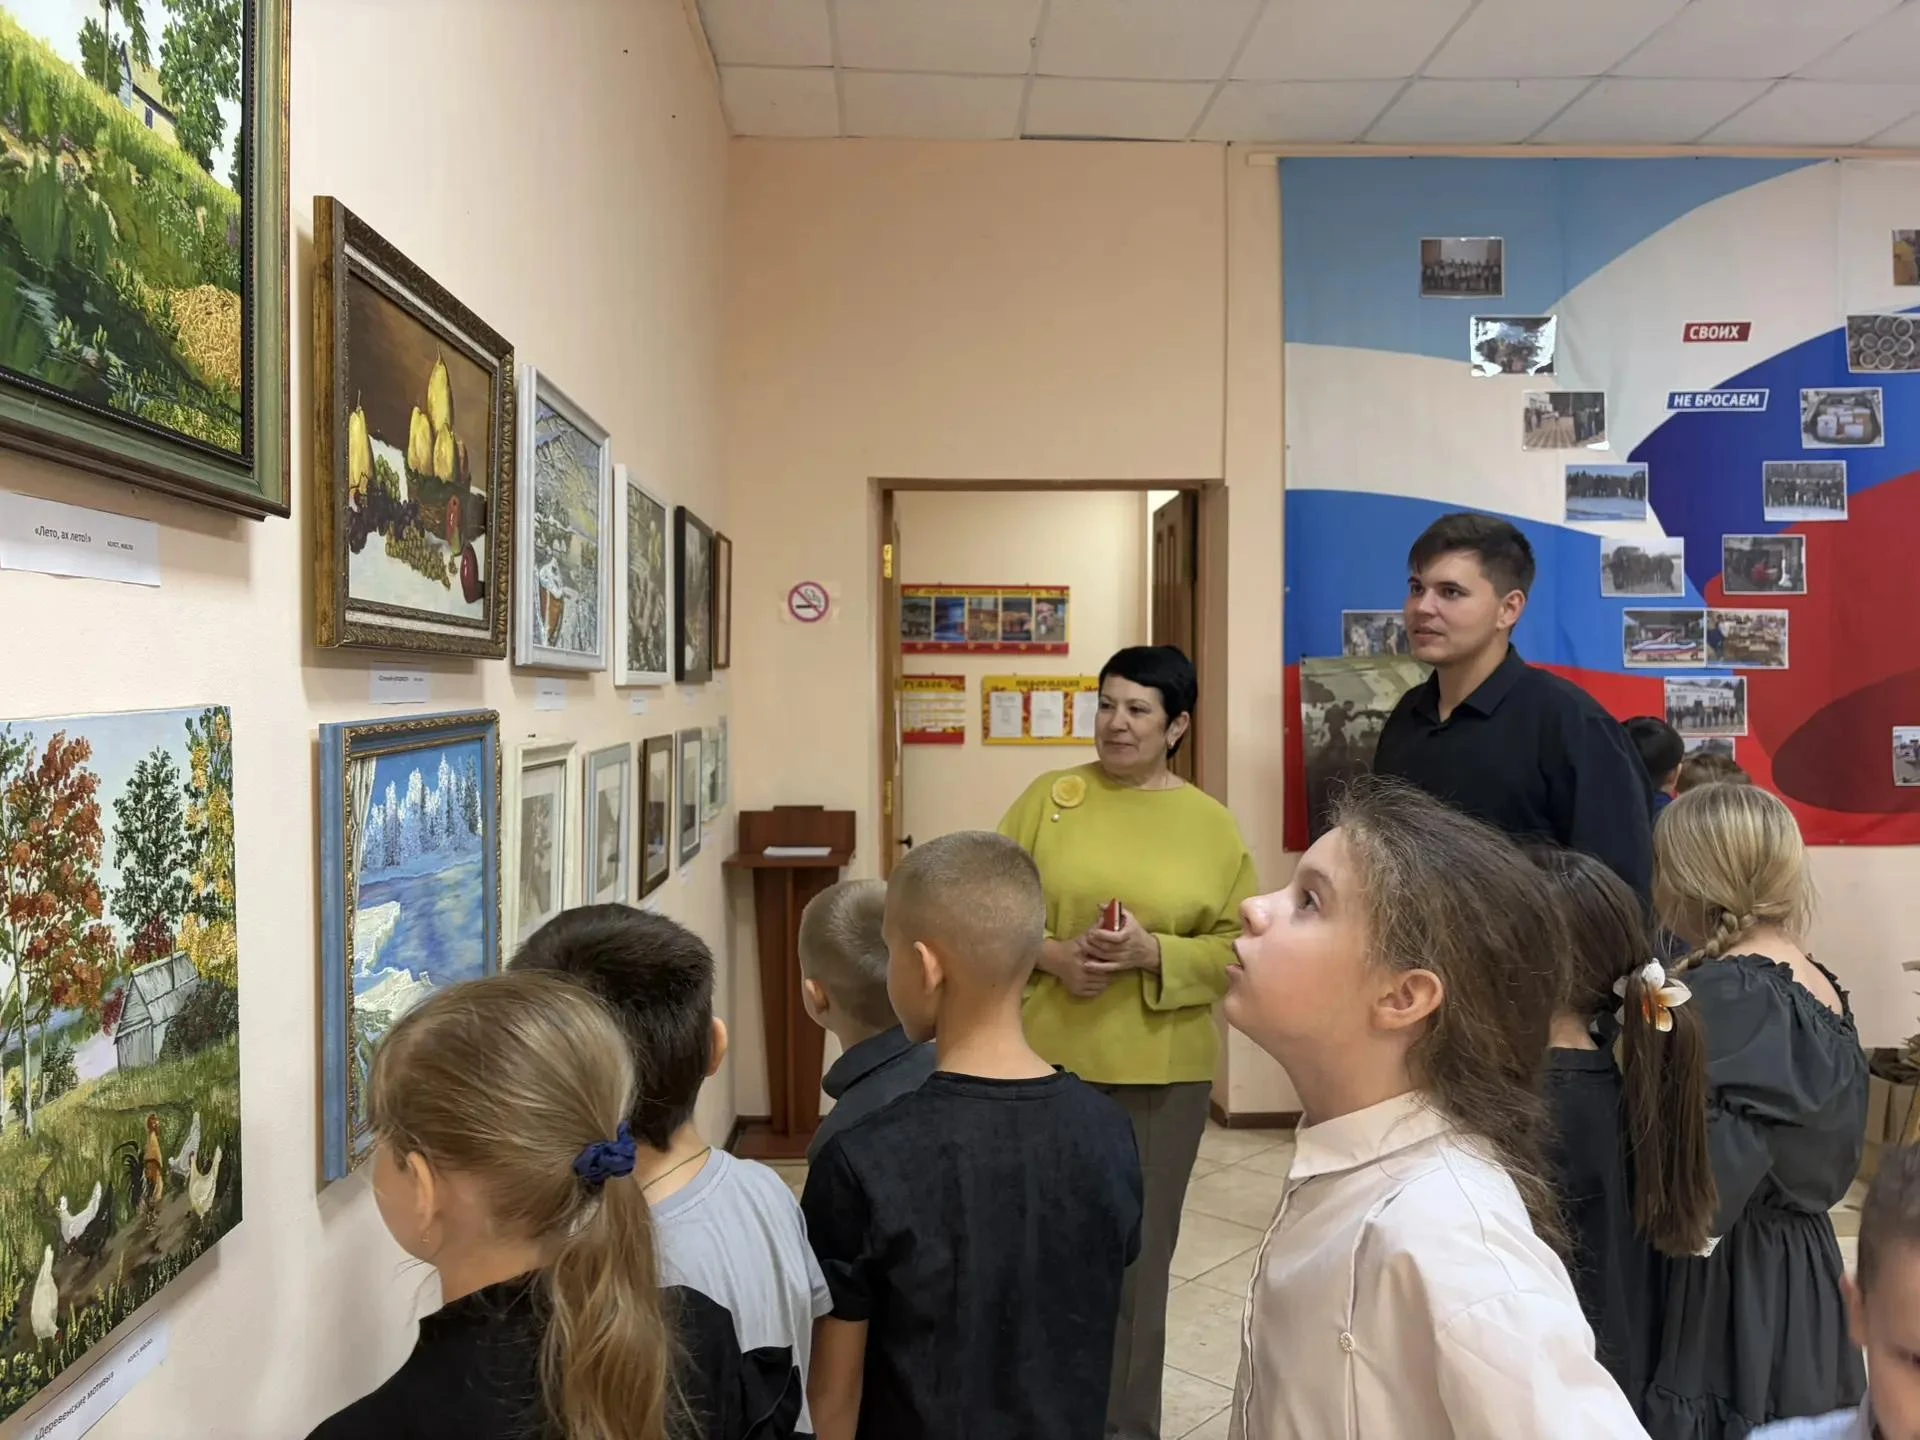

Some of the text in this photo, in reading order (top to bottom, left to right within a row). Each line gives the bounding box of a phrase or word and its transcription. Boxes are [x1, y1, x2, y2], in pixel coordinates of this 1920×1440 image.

[1689, 325, 1740, 340] СВОИХ
[1673, 392, 1760, 407] НЕ БРОСАЕМ
[34, 525, 60, 541] «Лето,
[61, 531, 69, 540] ах
[70, 532, 92, 544] лето!»
